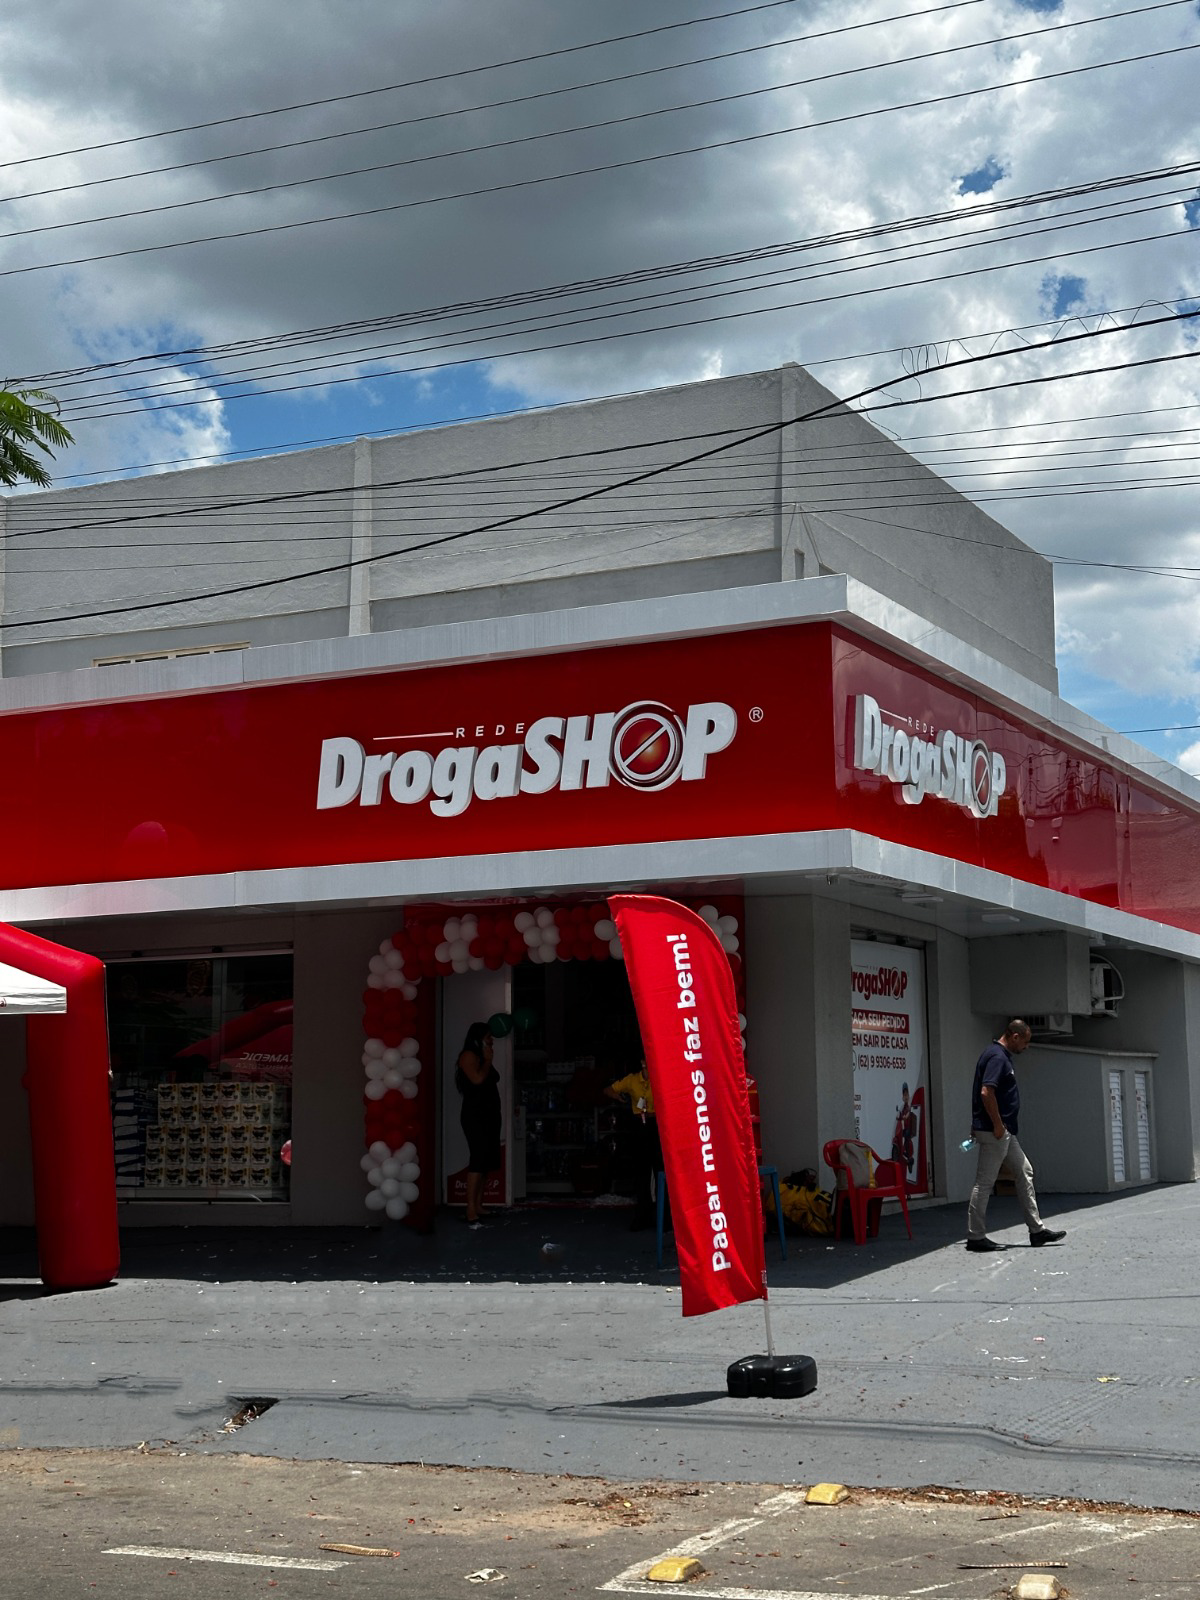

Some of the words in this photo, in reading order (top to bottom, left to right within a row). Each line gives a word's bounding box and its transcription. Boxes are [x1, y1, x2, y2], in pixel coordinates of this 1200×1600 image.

[455, 722, 525, 738] REDE
[907, 717, 935, 736] REDE
[316, 700, 738, 818] DrogaSHOP
[854, 694, 1006, 818] DrogaSHOP
[666, 933, 696, 1009] bem!
[851, 966, 908, 1000] rogaSHOP
[684, 1017, 703, 1063] faz
[852, 1033, 862, 1047] EM
[863, 1034, 879, 1048] SAIR
[881, 1035, 890, 1049] DE
[891, 1036, 909, 1051] CASA
[868, 1013, 881, 1027] SEU
[881, 1014, 906, 1030] PEDIDO
[690, 1069, 716, 1173] menos
[704, 1181, 731, 1273] Pagar
